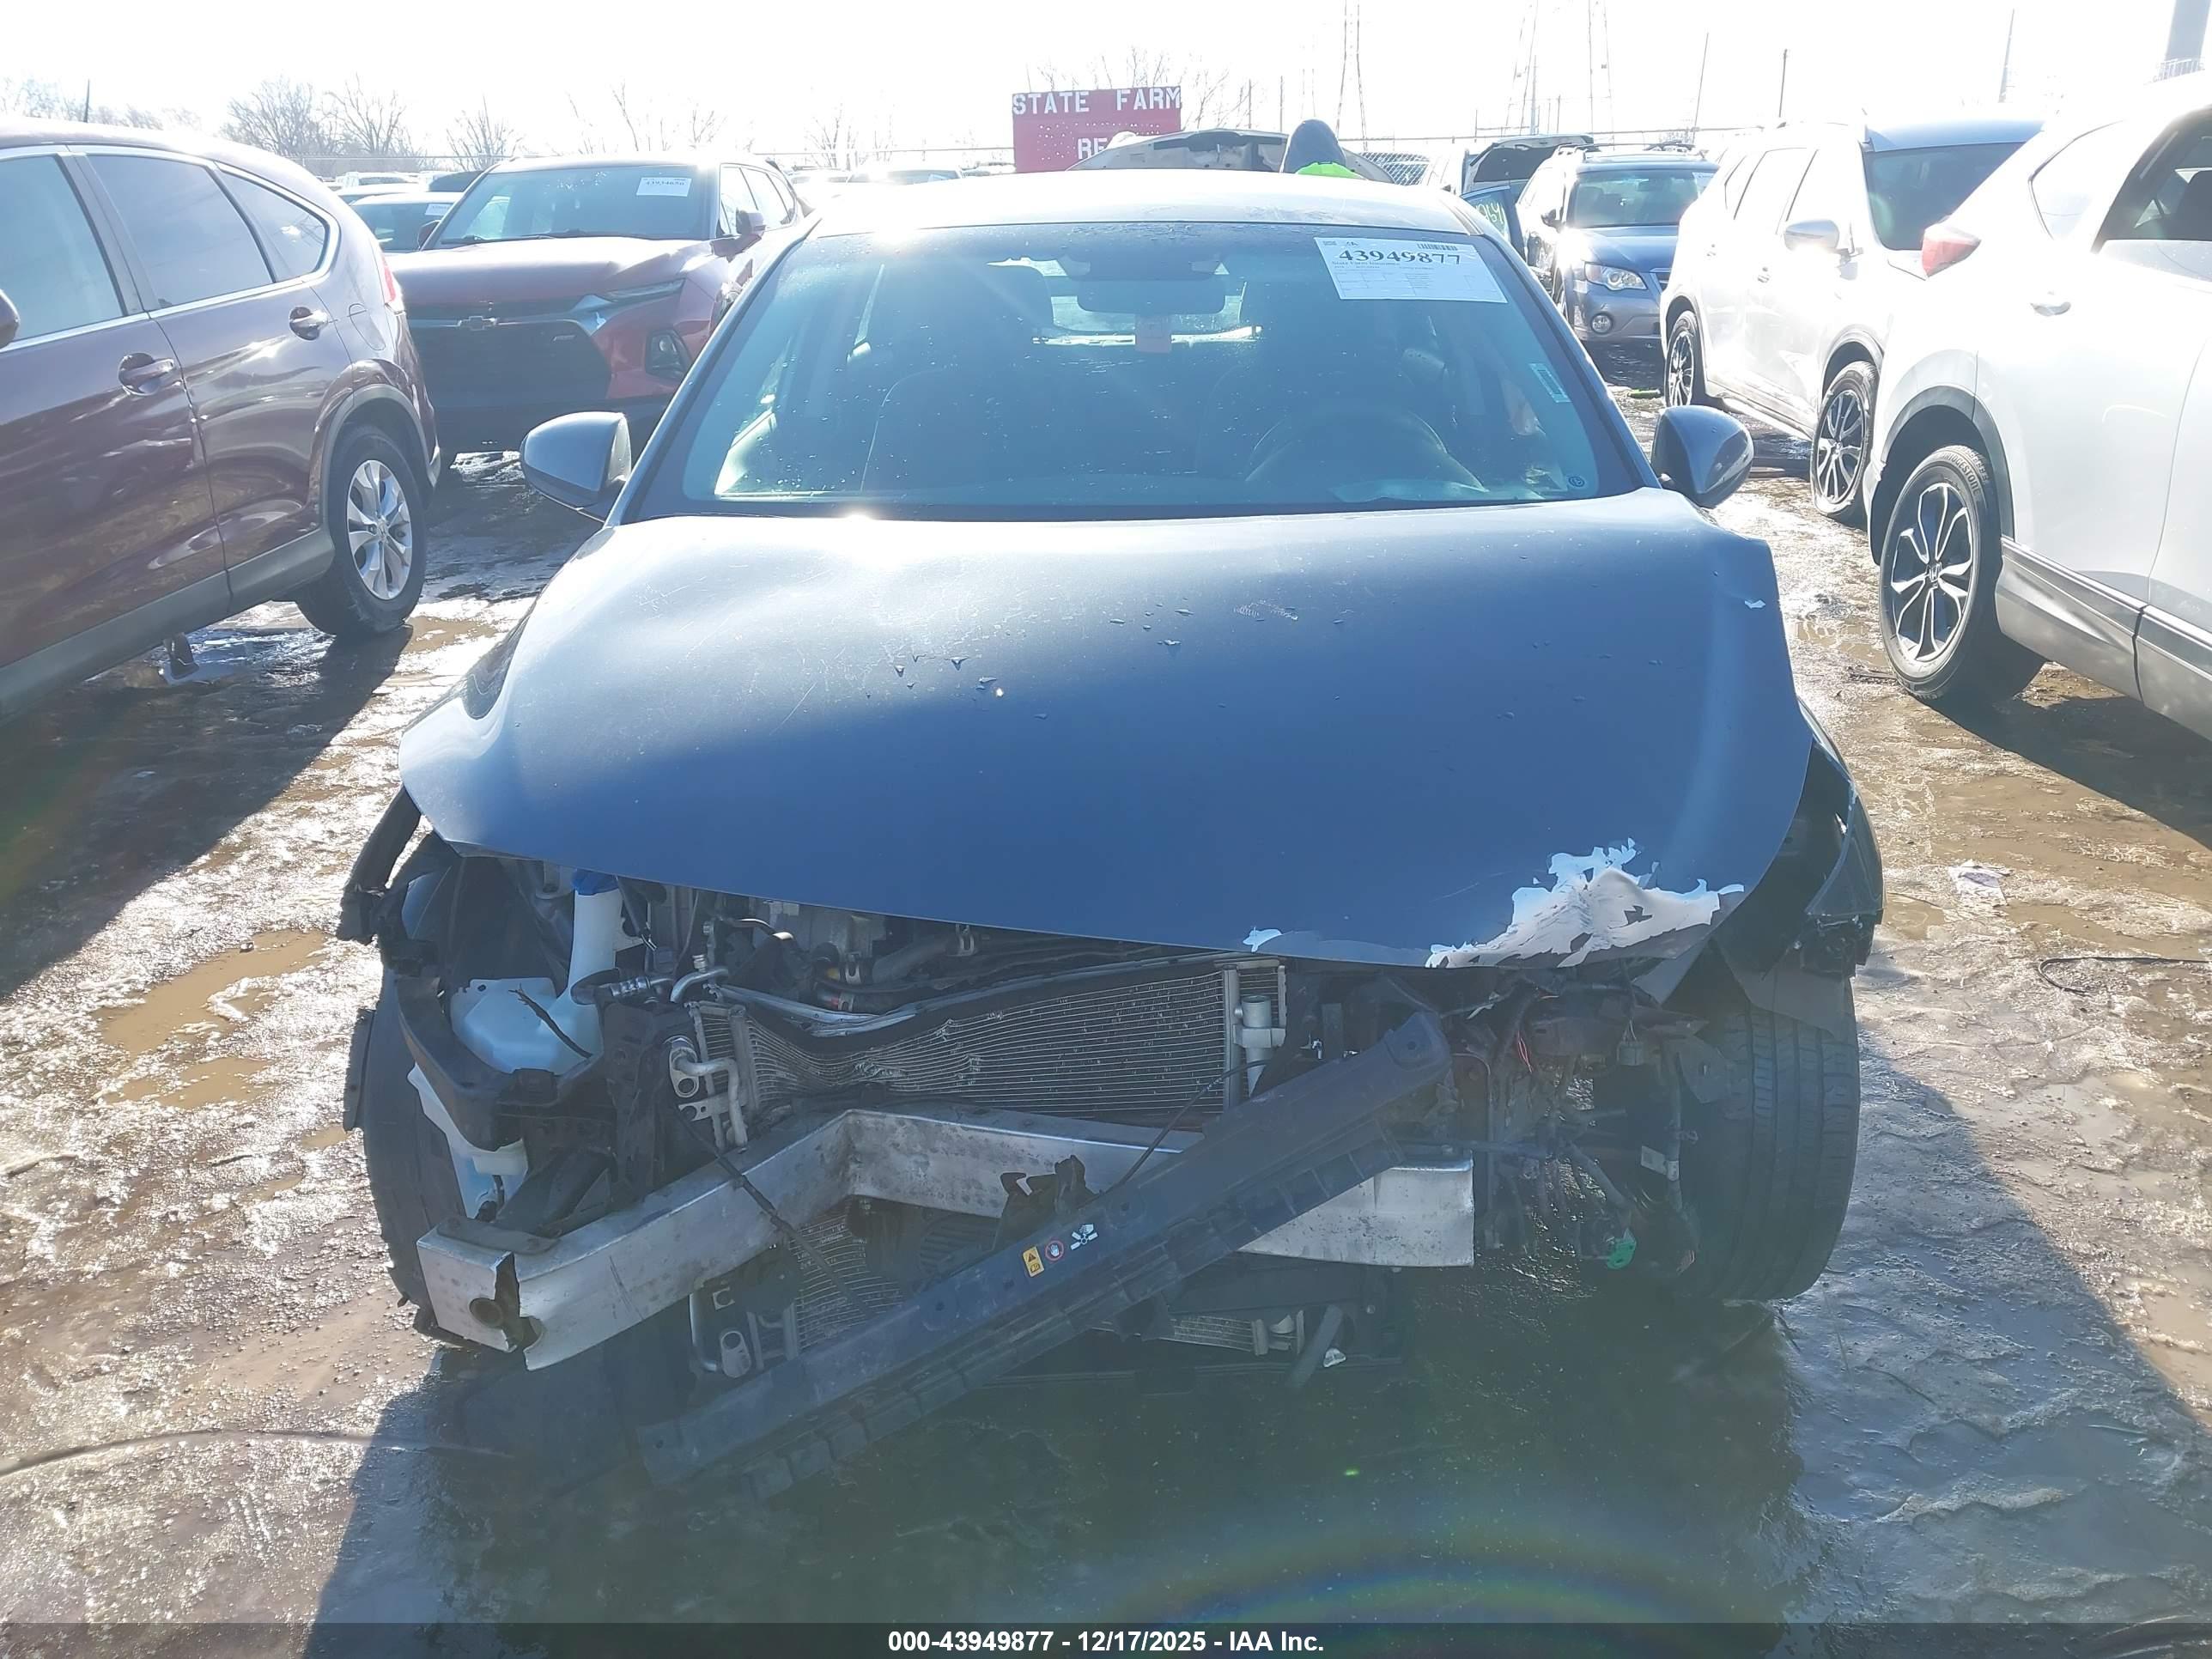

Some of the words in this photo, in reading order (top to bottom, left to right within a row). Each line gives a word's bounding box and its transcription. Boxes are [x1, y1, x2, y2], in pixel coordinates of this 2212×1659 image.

[1012, 91, 1090, 115] STATE
[1116, 87, 1181, 111] FARM
[1339, 250, 1460, 265] 43949877
